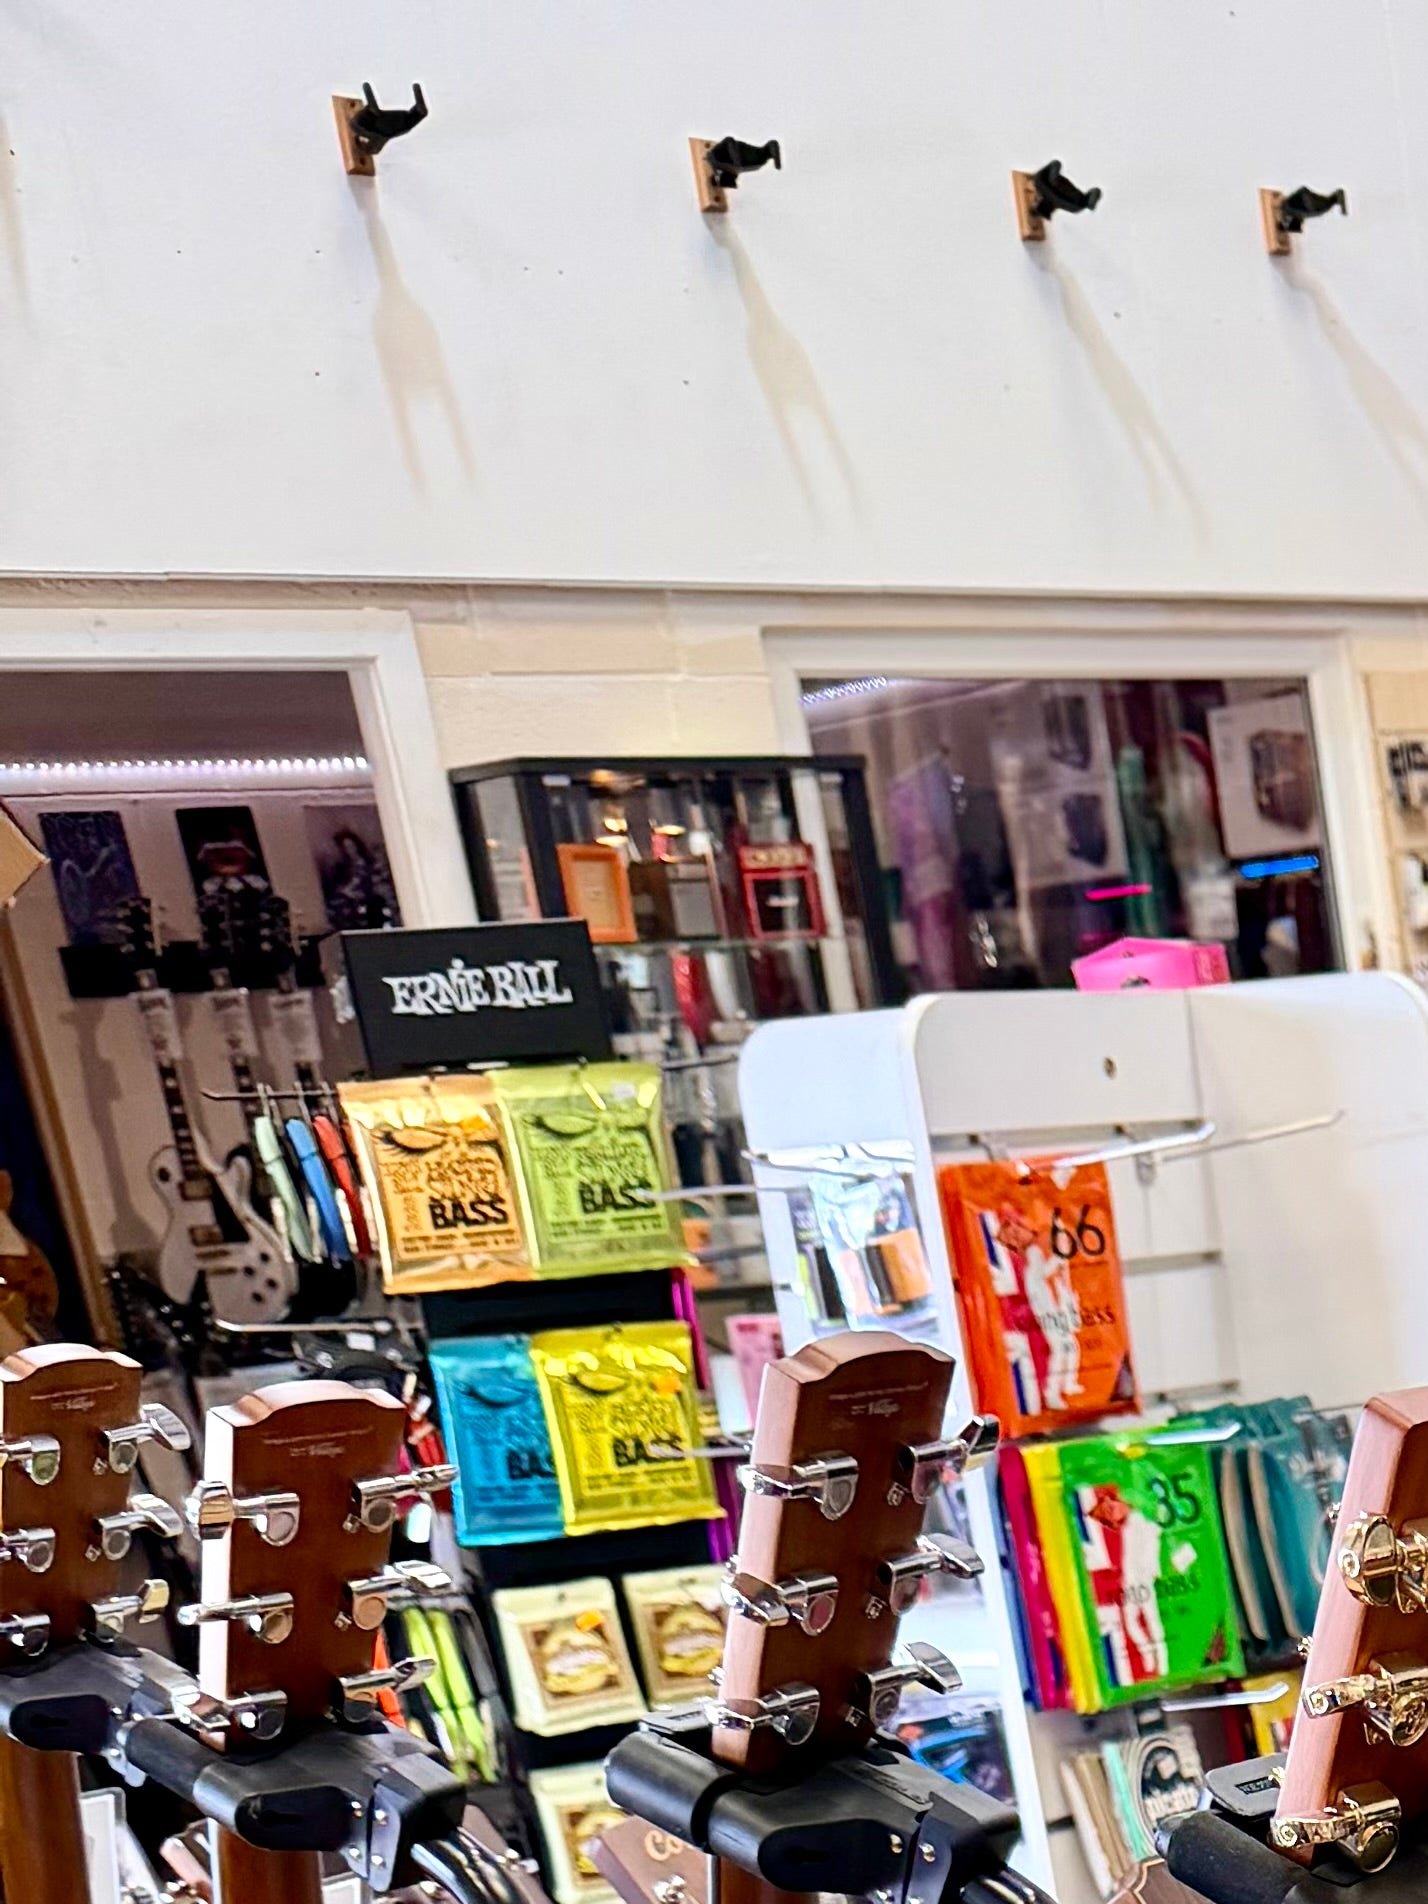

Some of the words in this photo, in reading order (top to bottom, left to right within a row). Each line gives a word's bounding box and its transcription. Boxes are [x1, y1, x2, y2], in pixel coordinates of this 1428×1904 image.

[382, 957, 486, 1016] ERNIE
[487, 959, 574, 1010] BALL
[429, 1197, 509, 1231] BASS
[1050, 1204, 1106, 1260] 66
